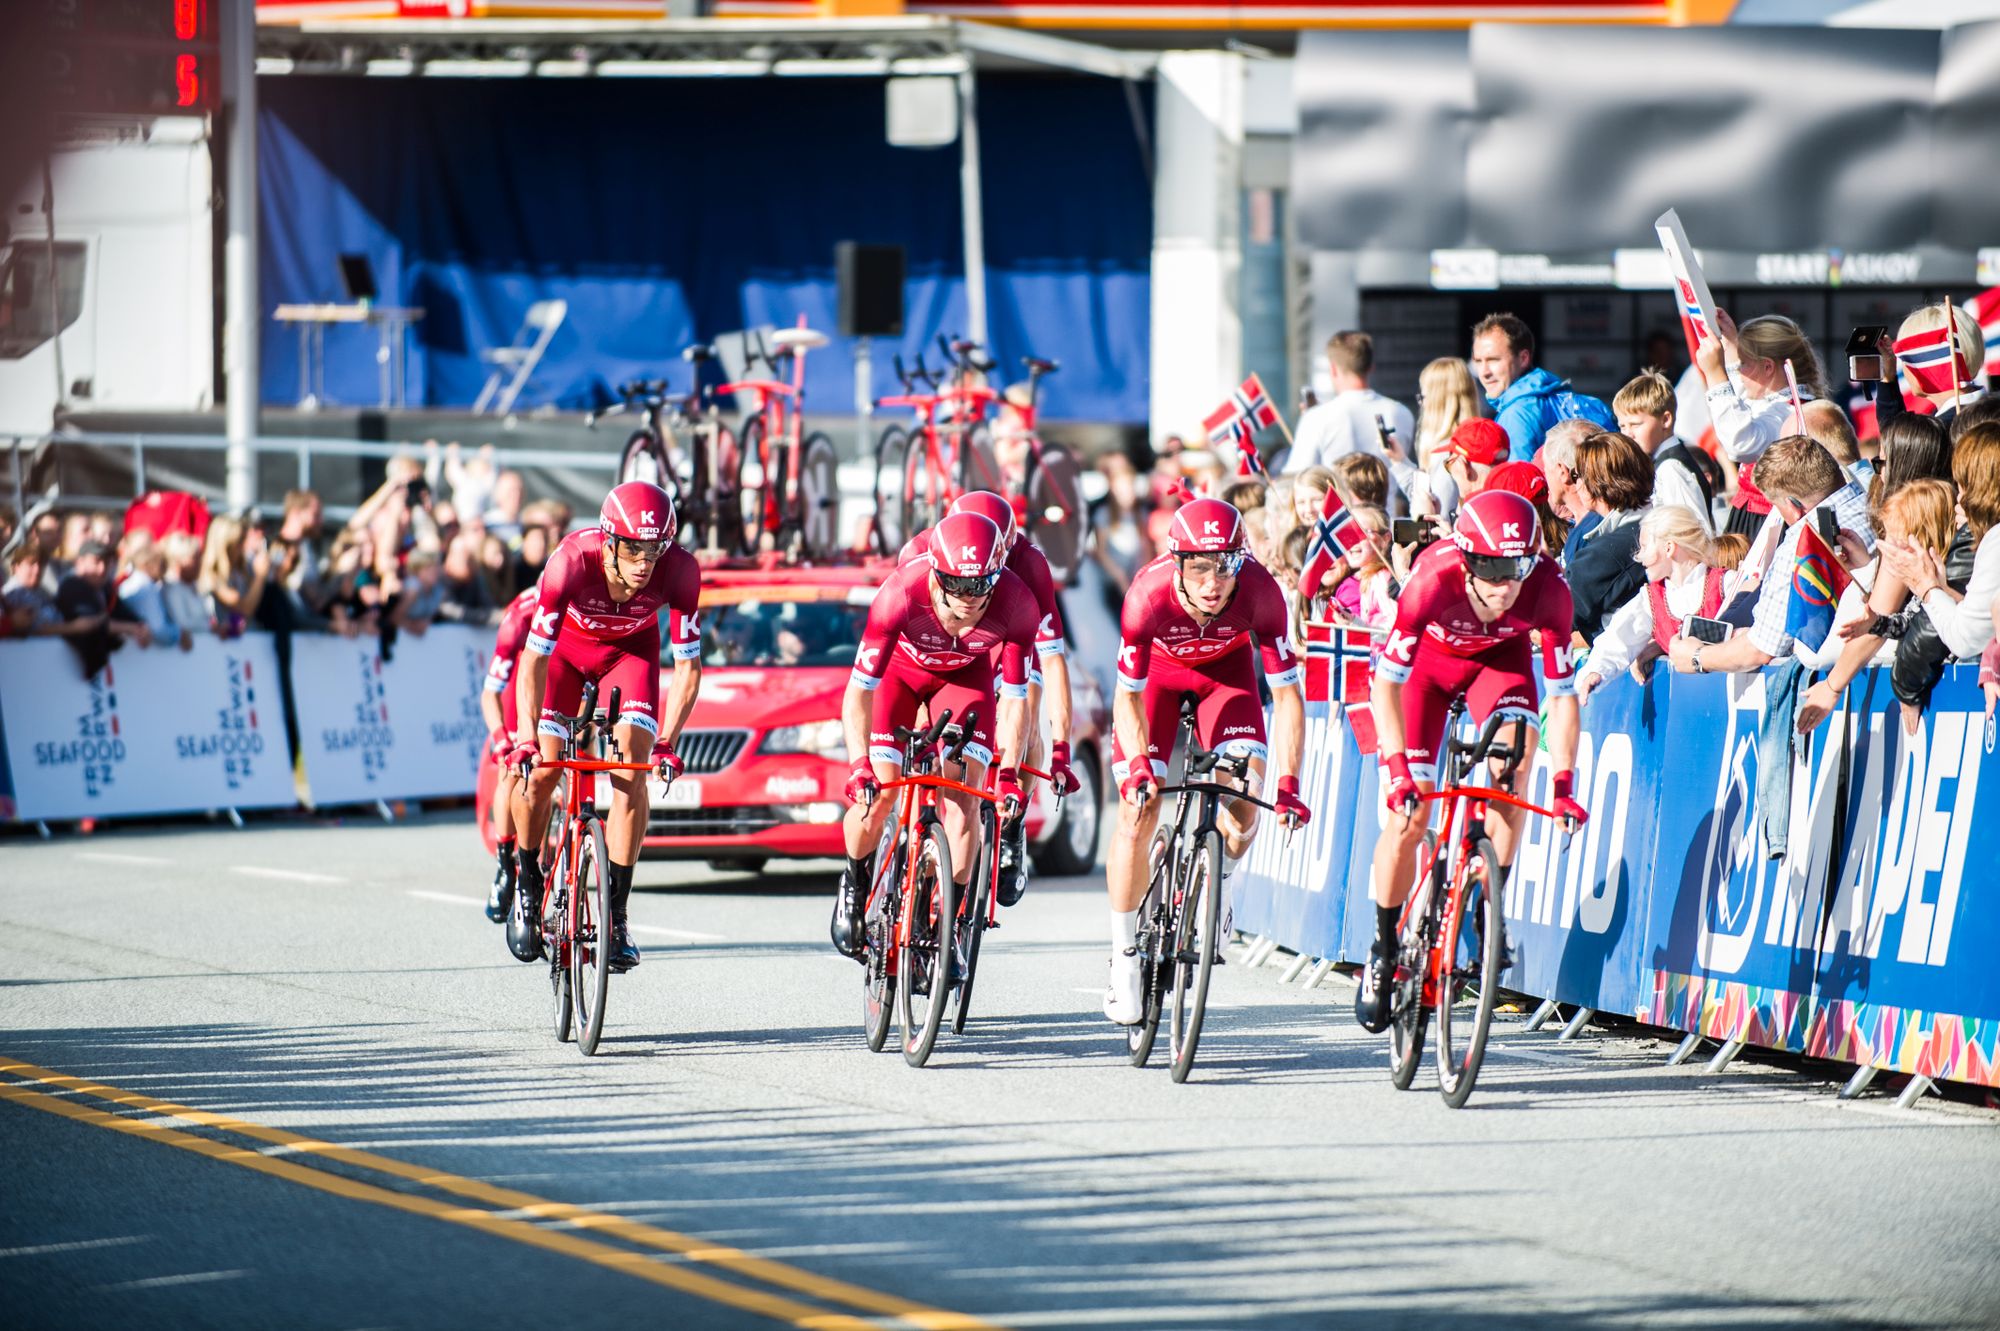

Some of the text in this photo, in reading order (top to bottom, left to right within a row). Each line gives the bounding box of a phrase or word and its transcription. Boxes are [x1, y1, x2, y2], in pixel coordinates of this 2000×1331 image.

[1757, 253, 1827, 284] START
[641, 510, 655, 525] K
[1204, 520, 1219, 535] K
[1502, 522, 1520, 539] K
[962, 545, 977, 560] K
[1499, 541, 1526, 549] GIRO
[532, 605, 560, 636] K
[680, 611, 700, 639] K
[855, 641, 880, 672] K
[1385, 629, 1418, 662] K
[1554, 641, 1575, 674] K
[489, 655, 513, 680] K
[623, 700, 653, 711] Alpecin
[1496, 695, 1530, 706] Alpecin
[1223, 725, 1257, 736] Alpecin
[34, 738, 126, 766] SEAFOOD
[176, 732, 264, 758] SEAFOOD
[1763, 709, 1986, 968] MAPEI
